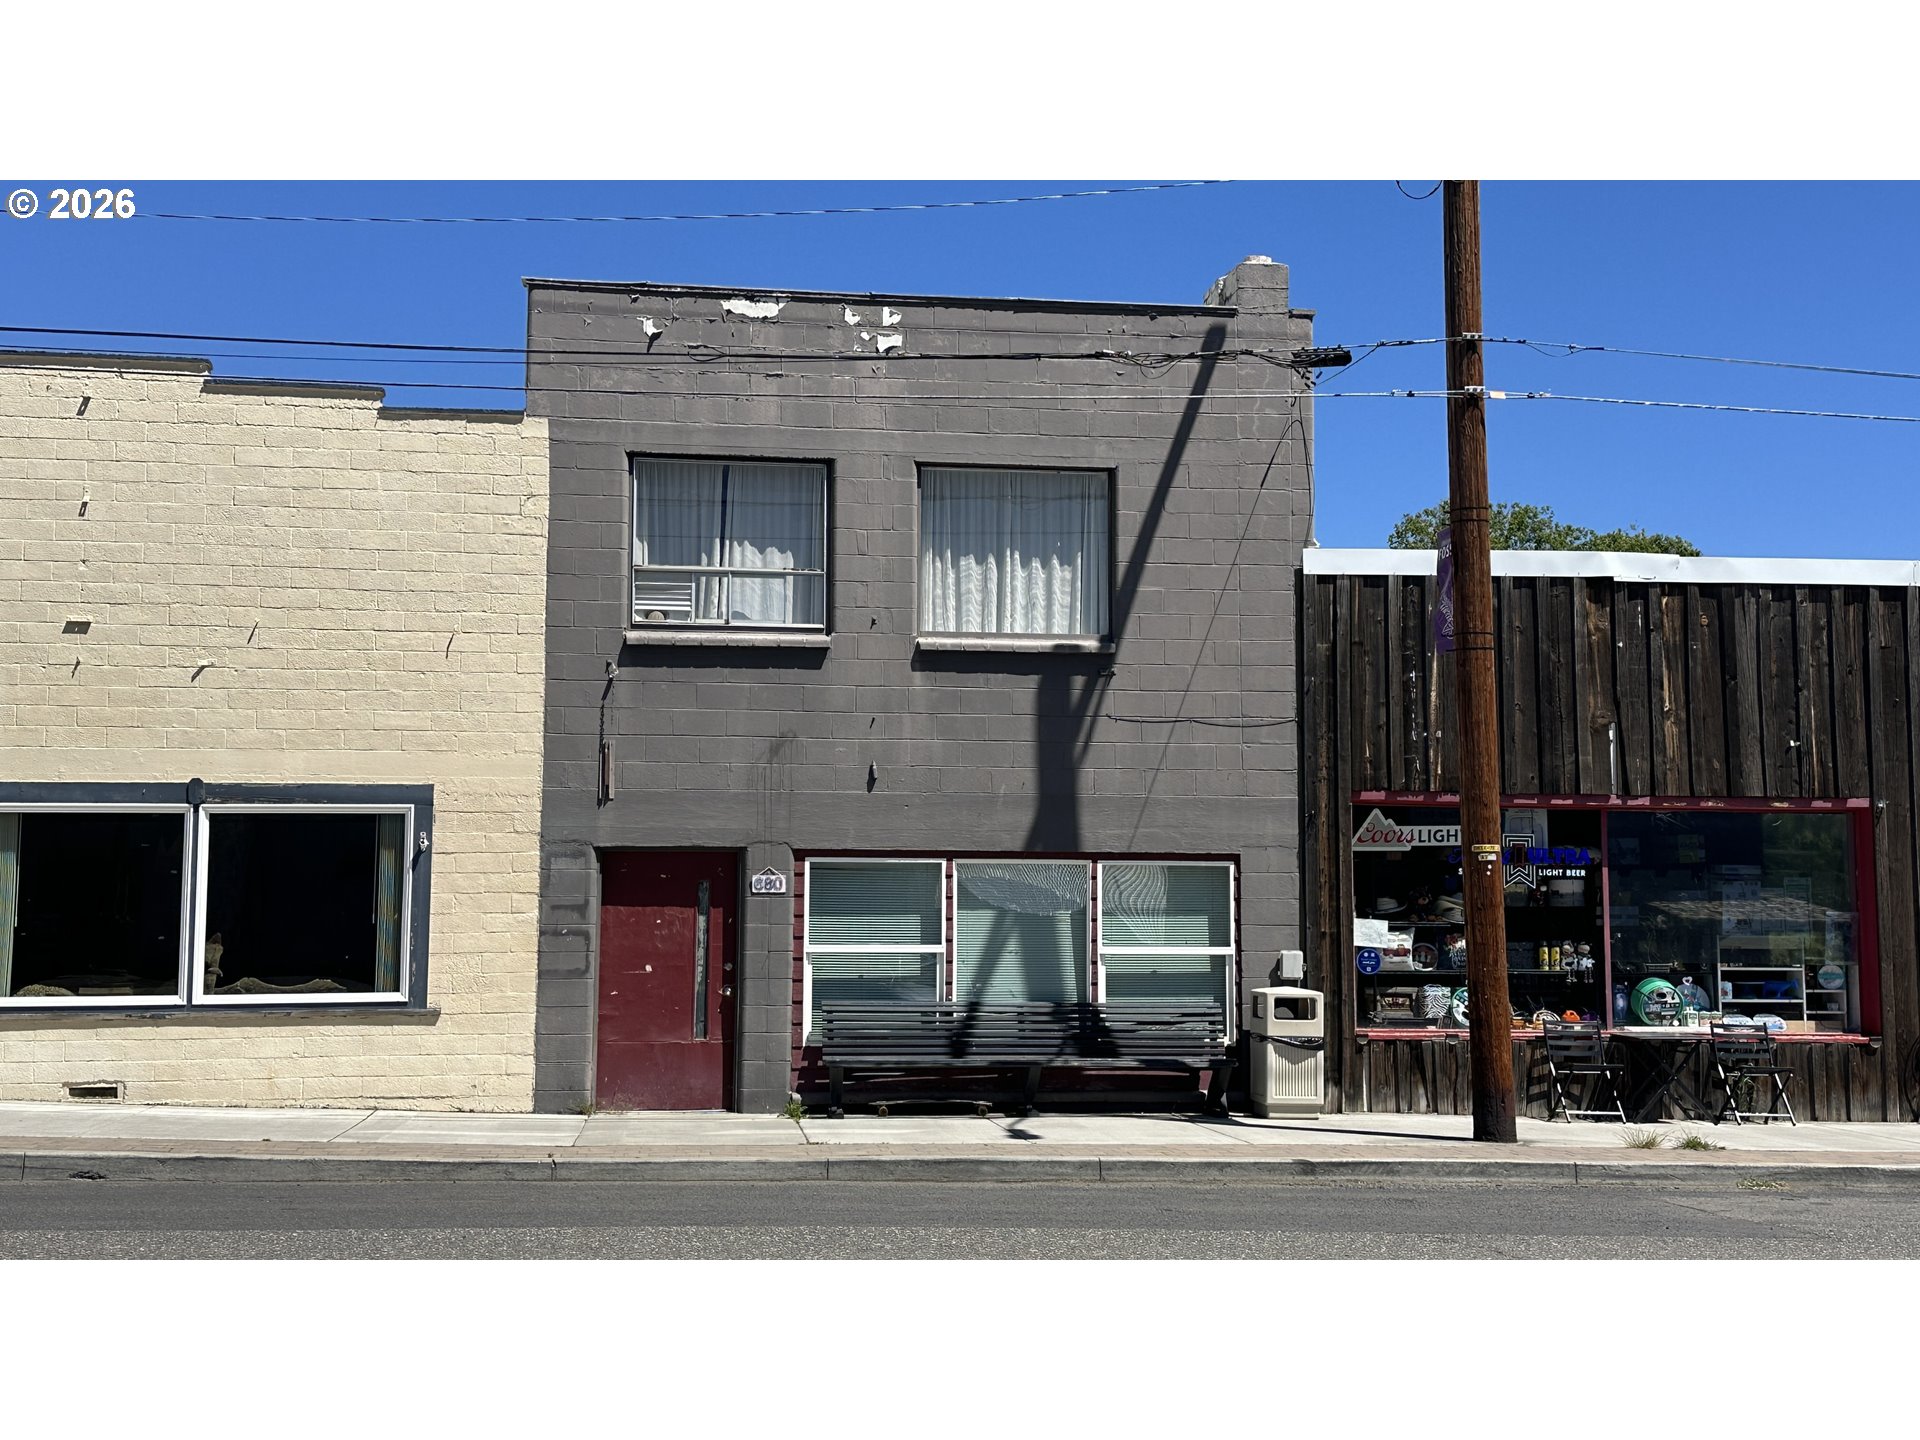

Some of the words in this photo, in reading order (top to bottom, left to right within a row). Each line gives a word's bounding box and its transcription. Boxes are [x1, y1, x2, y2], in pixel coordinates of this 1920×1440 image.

[1356, 822, 1416, 844] Coors
[1418, 829, 1460, 843] LIGH
[1527, 847, 1592, 865] ULTRA
[1538, 868, 1563, 877] LIGHT
[1566, 868, 1586, 877] BEER
